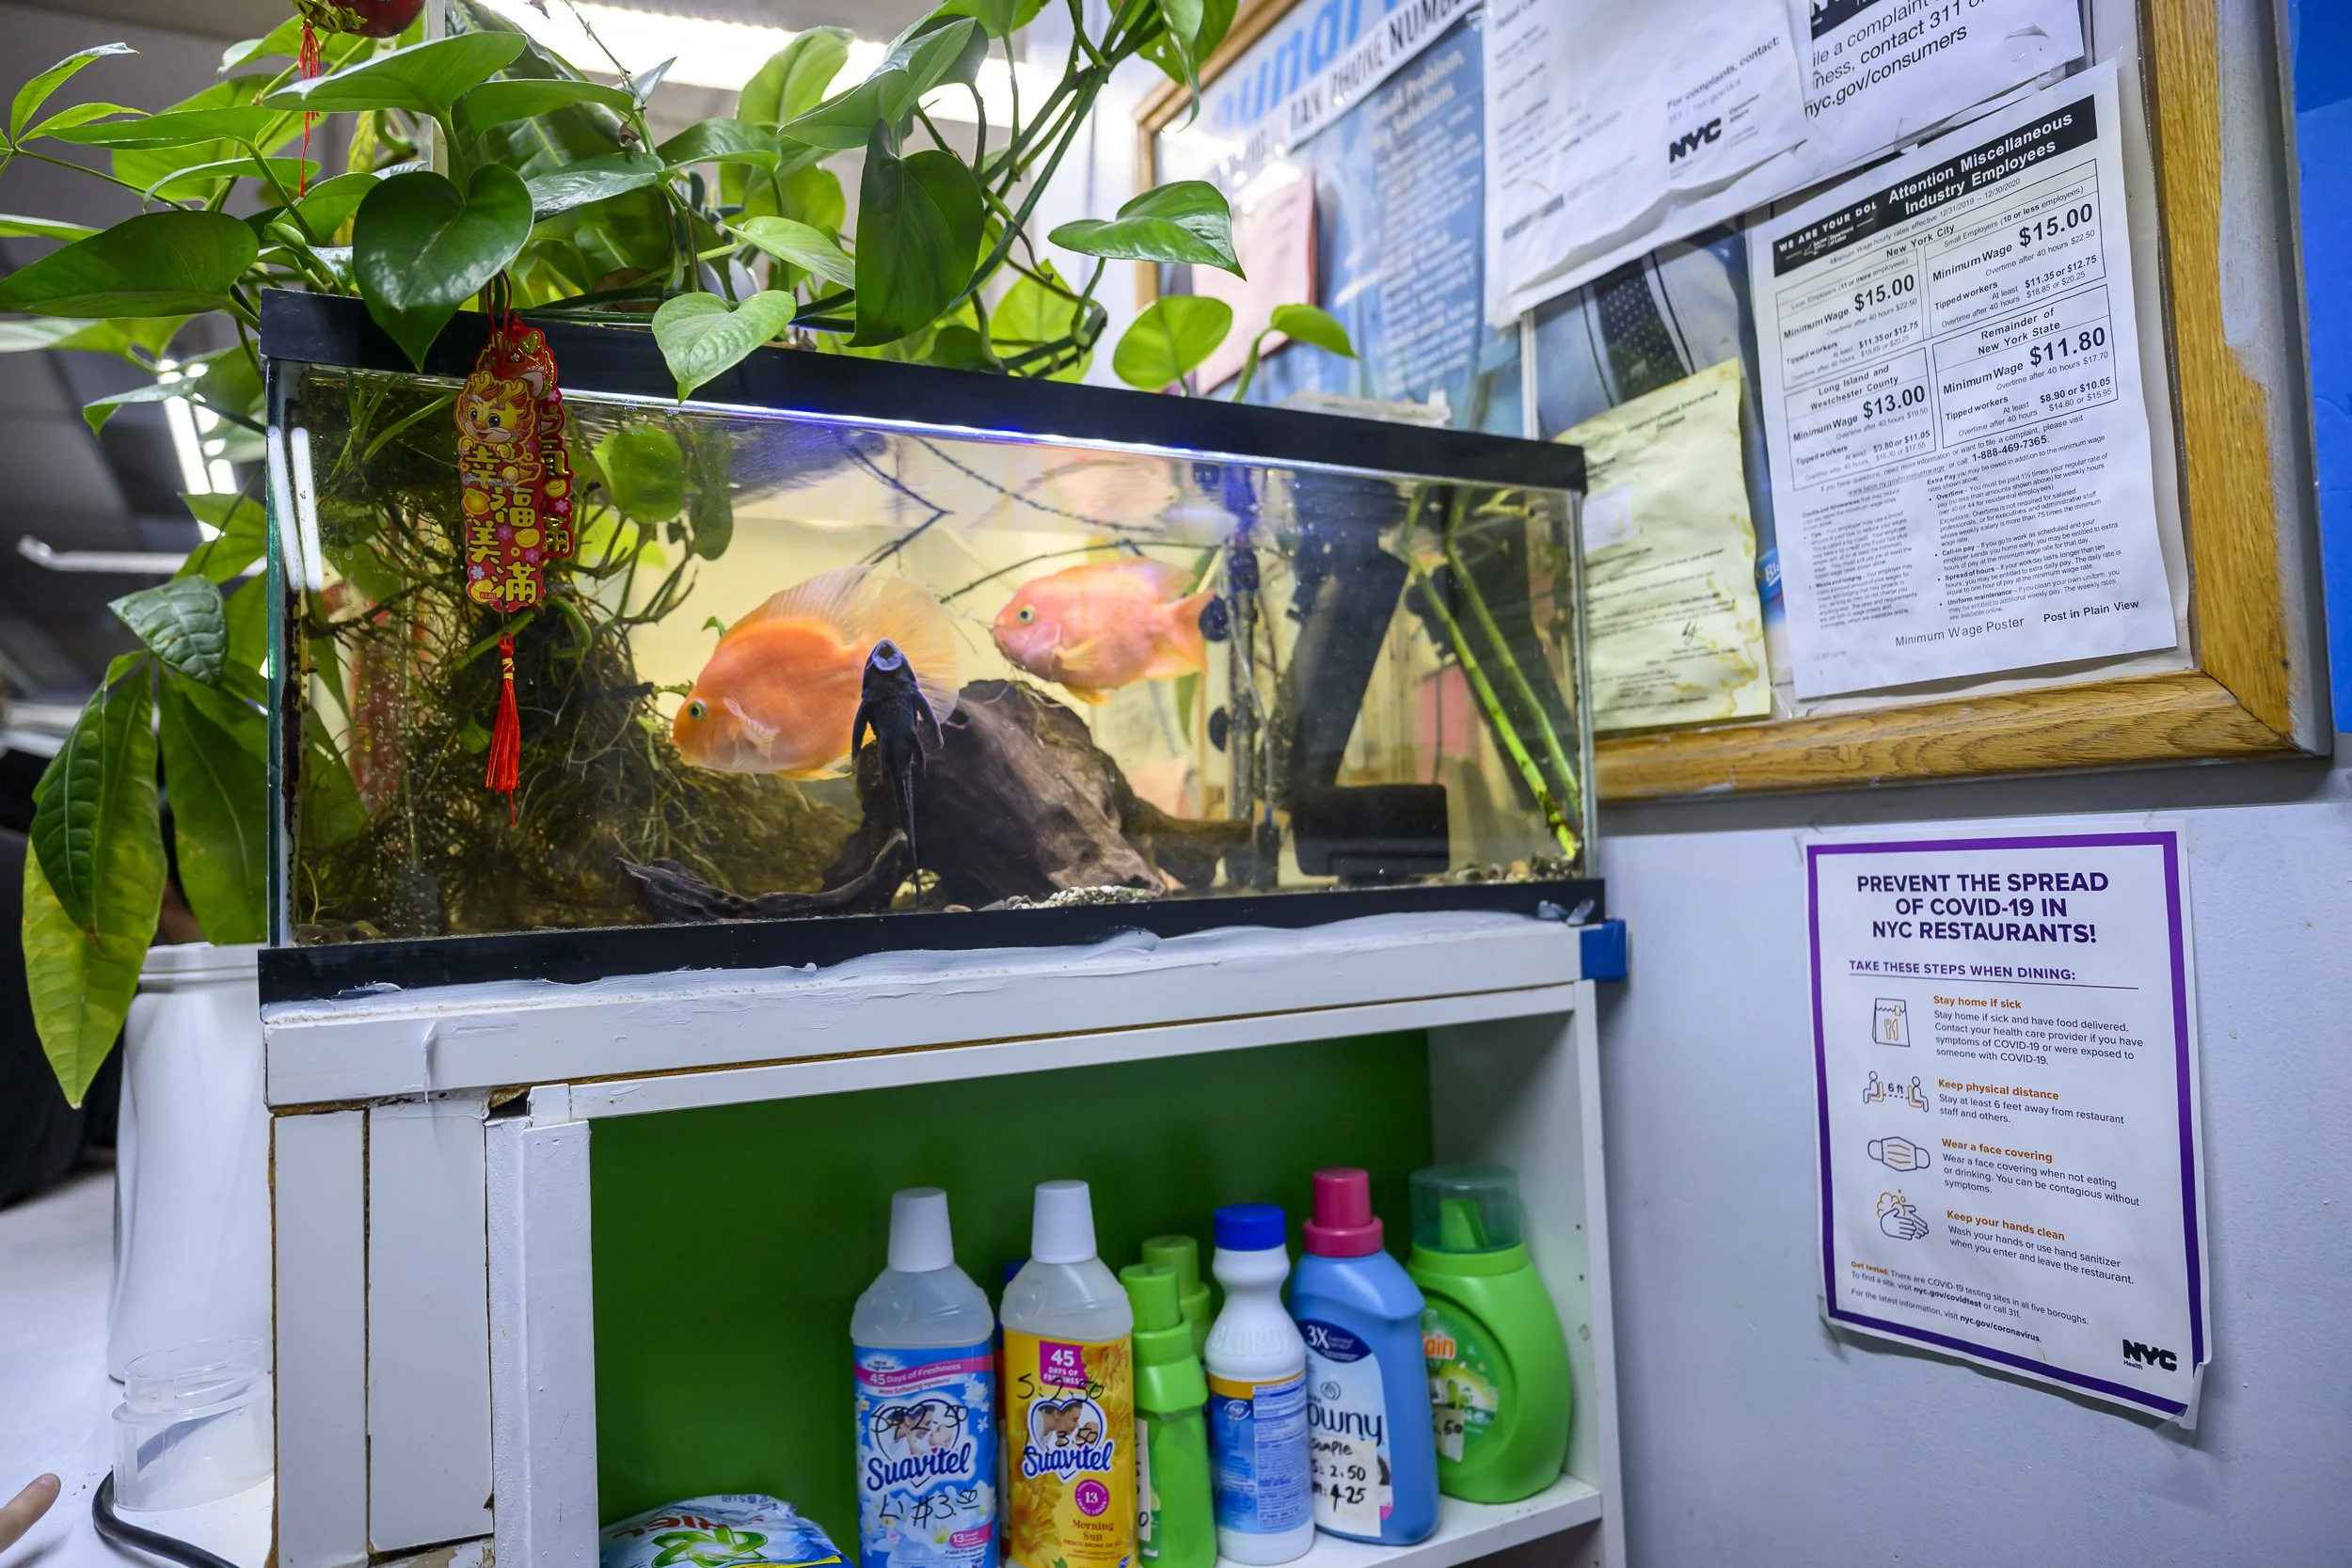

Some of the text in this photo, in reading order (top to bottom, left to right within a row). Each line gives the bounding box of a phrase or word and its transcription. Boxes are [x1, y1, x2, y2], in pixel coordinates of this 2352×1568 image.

[1739, 37, 1780, 67] contact:
[1813, 50, 1829, 68] ile
[1834, 42, 1843, 56] a
[1814, 2, 1961, 88] ness, contact 311
[1804, 25, 1967, 119] nyc.gov/consumers
[1669, 117, 1722, 164] NYC
[1888, 114, 2073, 204] Attention Miscellaneous
[1904, 141, 2056, 214] Industry Employees
[1779, 238, 1793, 252] WE
[1798, 228, 1818, 245] ARE
[1821, 213, 1850, 232] YOUR
[2018, 203, 2092, 246] $15.00
[1886, 225, 1956, 258] New York City
[1932, 244, 2012, 282] Minimum Wage
[2024, 255, 2096, 288] $11.35 or $12.75
[1854, 274, 1914, 310] $15.00
[1933, 281, 1997, 309] Tipped workers
[1980, 307, 2054, 340] Remainder of
[1978, 322, 2059, 356] New York State
[2029, 328, 2105, 366] $11.80
[1809, 375, 1898, 410] Westchester County
[1818, 363, 1888, 396] Long Island and
[1863, 386, 1925, 420] $13.00
[1971, 436, 2049, 461] 1-888-469-7365.
[2042, 610, 2067, 623] Post
[2083, 605, 2109, 616] Plain
[2113, 600, 2138, 610] View
[1895, 617, 2024, 646] Minimum Wage Poster
[1856, 872, 2108, 892] PREVENT THE SPREAD
[1895, 897, 2067, 917] OF COVID-19 IN
[1872, 920, 2096, 943] NYC RESTAURANTS!
[1848, 959, 2075, 980] TAKE THESE STEPS WHEN DINING:
[1932, 994, 2021, 1008] Stay home if sick
[1934, 1022, 2143, 1046] Contact your health care provider if you have
[1887, 1082, 1903, 1094] 6 ft
[1938, 1078, 2058, 1100] Keep physical distance
[1941, 1137, 1967, 1149] Wear
[1979, 1143, 2001, 1154] face
[2004, 1148, 2052, 1164] covering
[1947, 1209, 2064, 1241] Keep your hands clean
[1949, 1238, 2134, 1284] when you enter and leave the restaurant.
[1850, 1287, 2042, 1342] For the latest information, visit nyc.gov/coronavirus.
[1307, 1324, 1330, 1350] 3X
[1422, 1333, 1454, 1357] ain
[1050, 1349, 1075, 1368] 45
[2122, 1338, 2177, 1371] NYC
[2122, 1358, 2143, 1370] Health
[869, 1373, 885, 1386] 45
[886, 1374, 907, 1384] Days
[909, 1370, 916, 1379] of
[917, 1363, 961, 1377] Freshness
[1048, 1367, 1067, 1375] DAYS
[866, 1442, 972, 1491] Suavitel
[1023, 1441, 1113, 1477] Suavitel
[1330, 1465, 1366, 1481] 2.50
[1085, 1491, 1099, 1504] 13
[952, 1533, 964, 1544] 13
[1073, 1519, 1114, 1531] Morning
[1083, 1531, 1103, 1542] Sun
